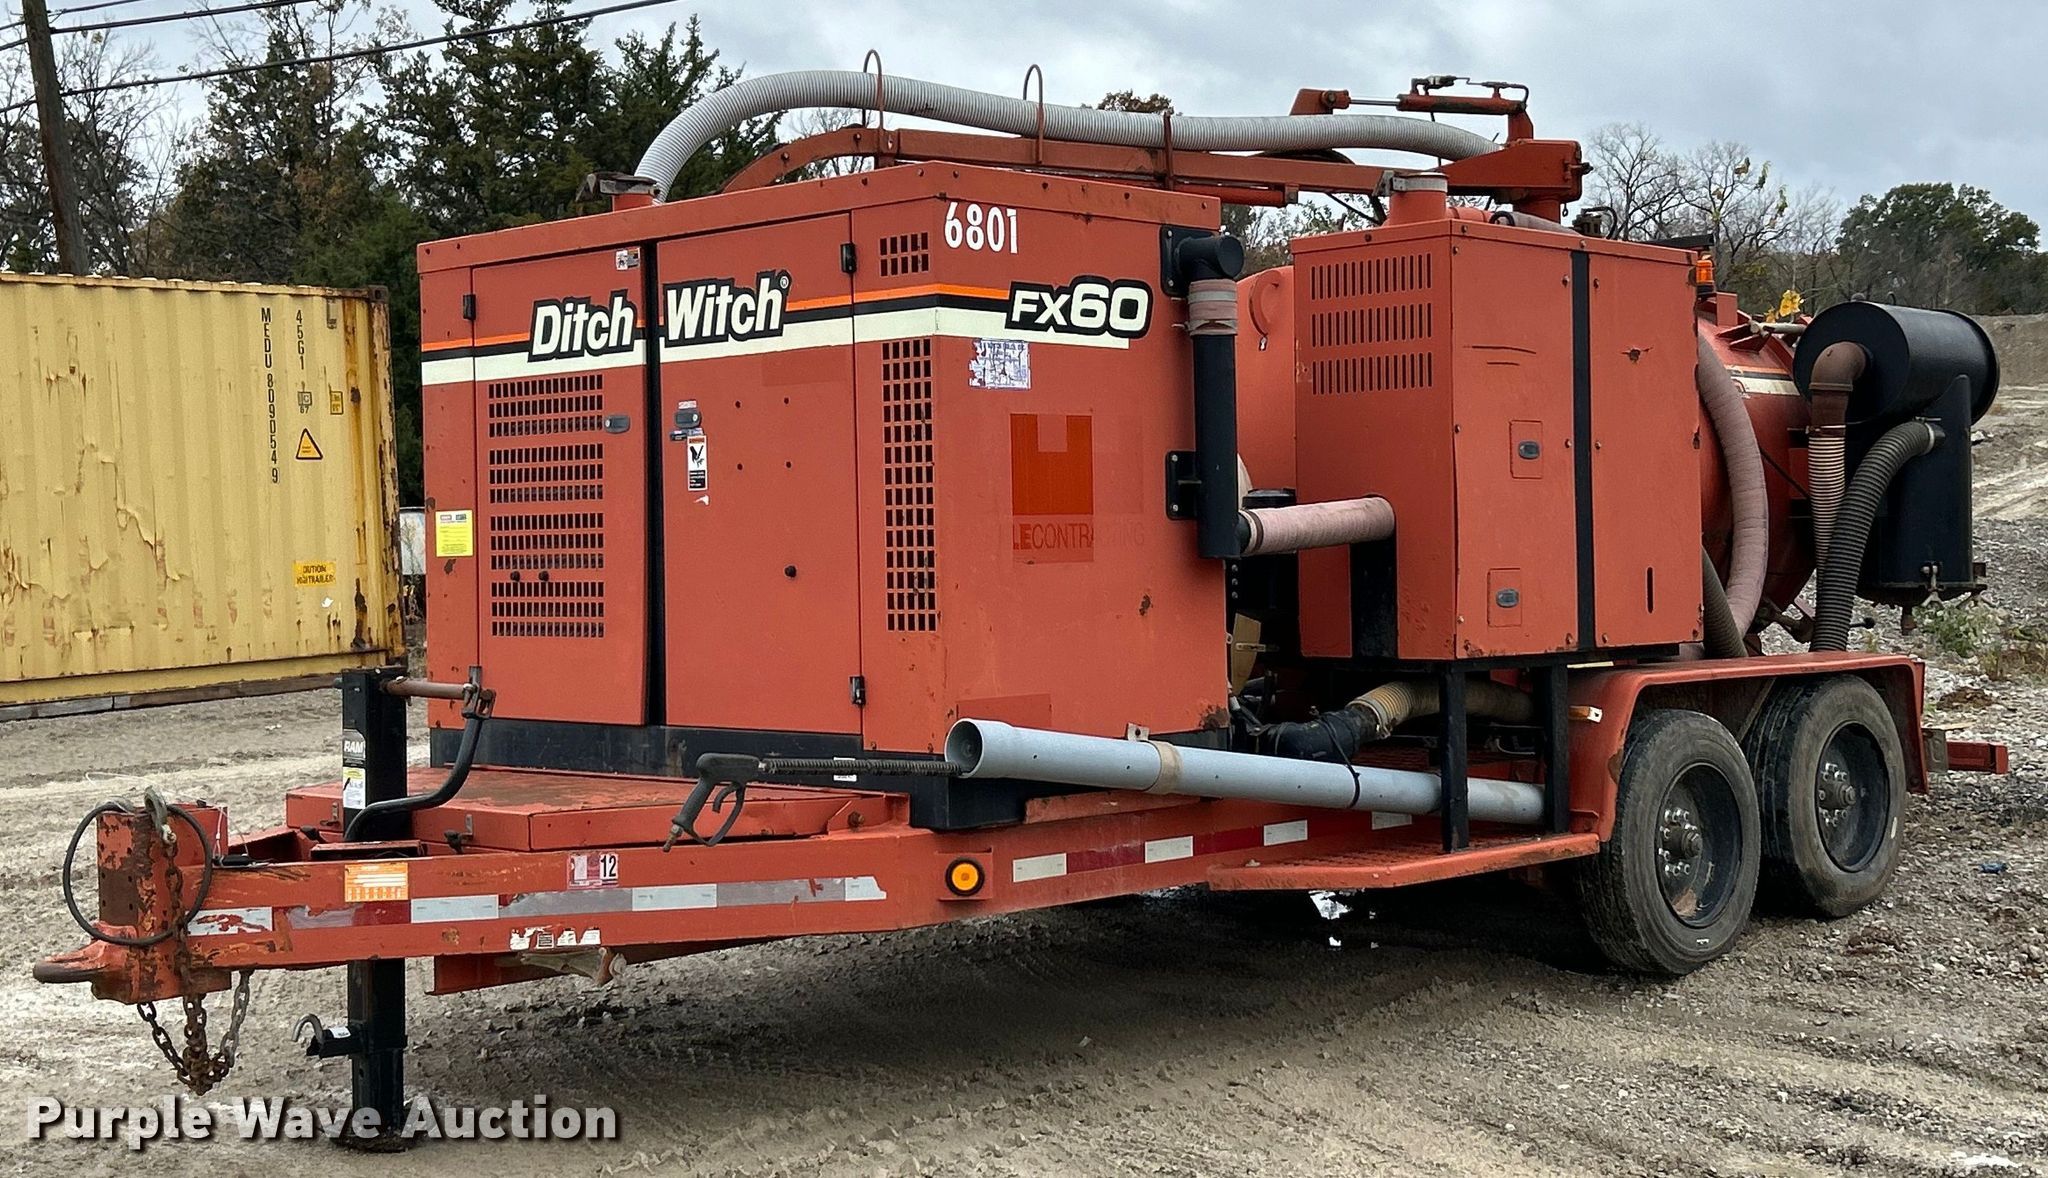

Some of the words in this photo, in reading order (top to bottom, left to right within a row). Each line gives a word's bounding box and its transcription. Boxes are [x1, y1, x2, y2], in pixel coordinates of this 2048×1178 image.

[944, 201, 1018, 254] 6801
[532, 296, 634, 355] Ditch
[666, 277, 783, 341] Witch
[1011, 283, 1149, 331] FX60
[261, 307, 272, 368] MEDU
[343, 740, 364, 753] RAM
[600, 855, 617, 878] 12
